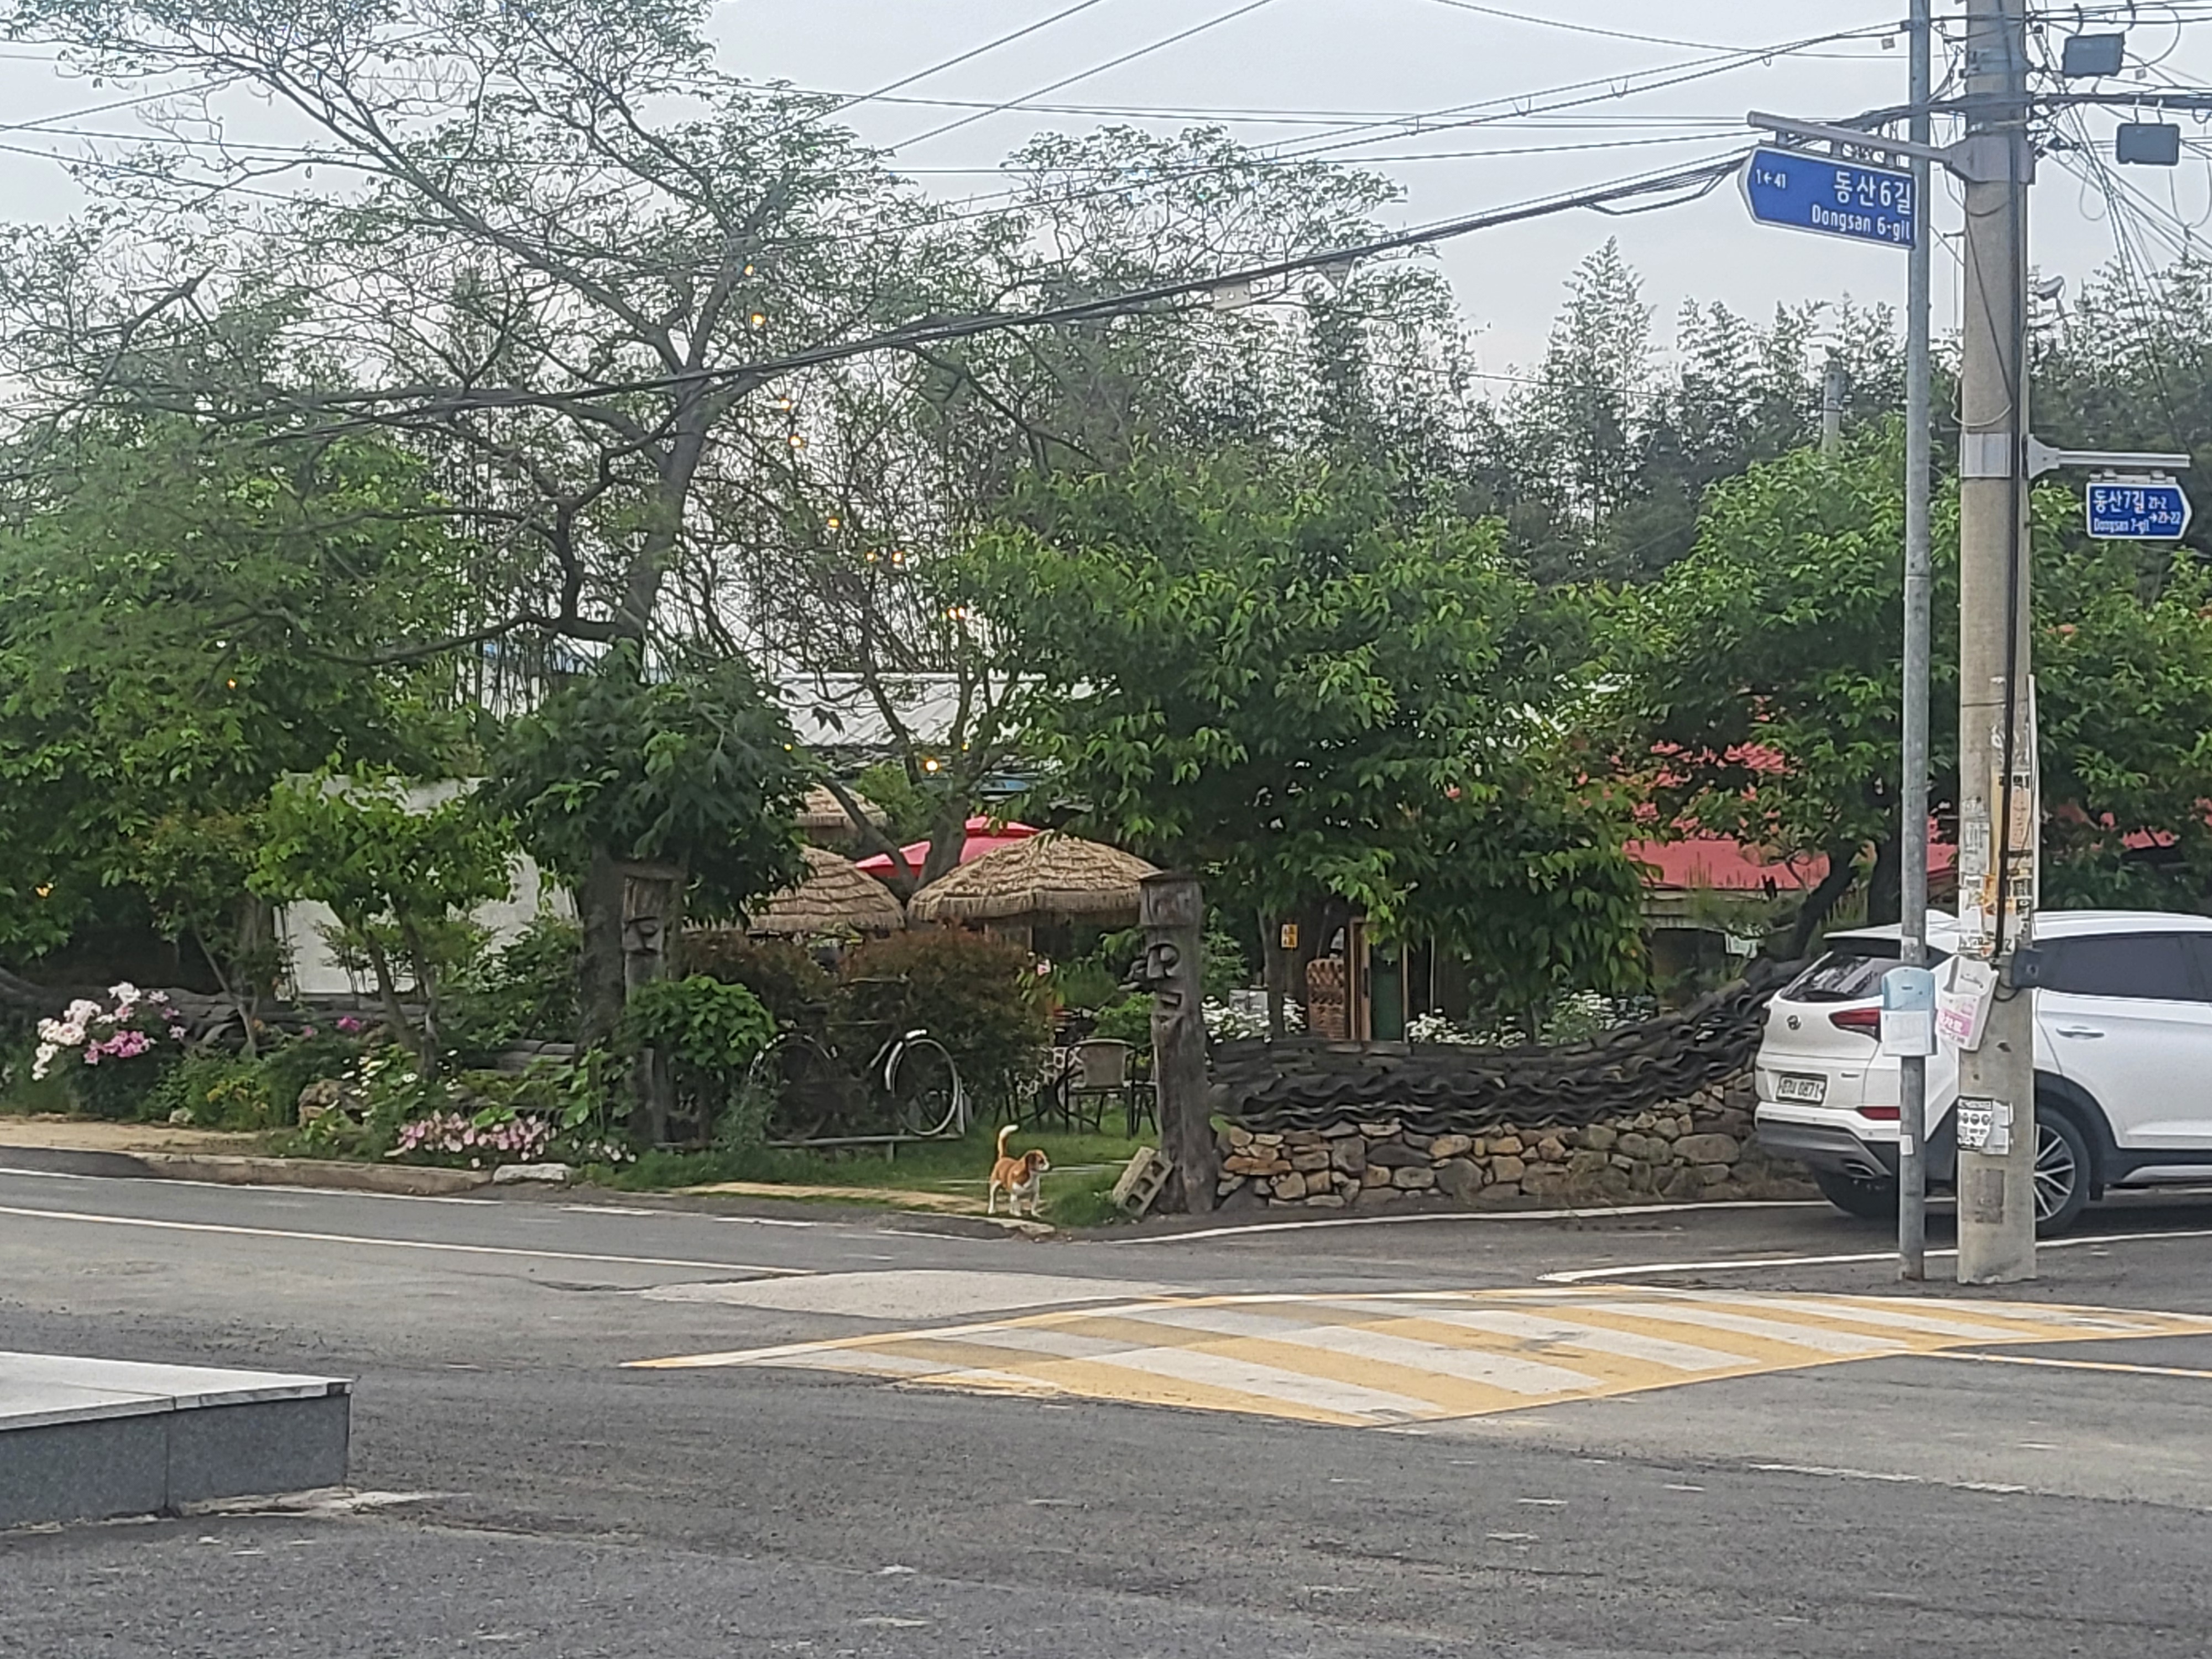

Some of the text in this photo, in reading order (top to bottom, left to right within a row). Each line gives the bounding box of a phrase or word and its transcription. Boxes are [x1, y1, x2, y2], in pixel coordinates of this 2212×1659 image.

[1834, 170, 1911, 215] 동산6길
[1811, 204, 1911, 241] Dongsan 6-gil
[2093, 489, 2146, 514] 동산7길
